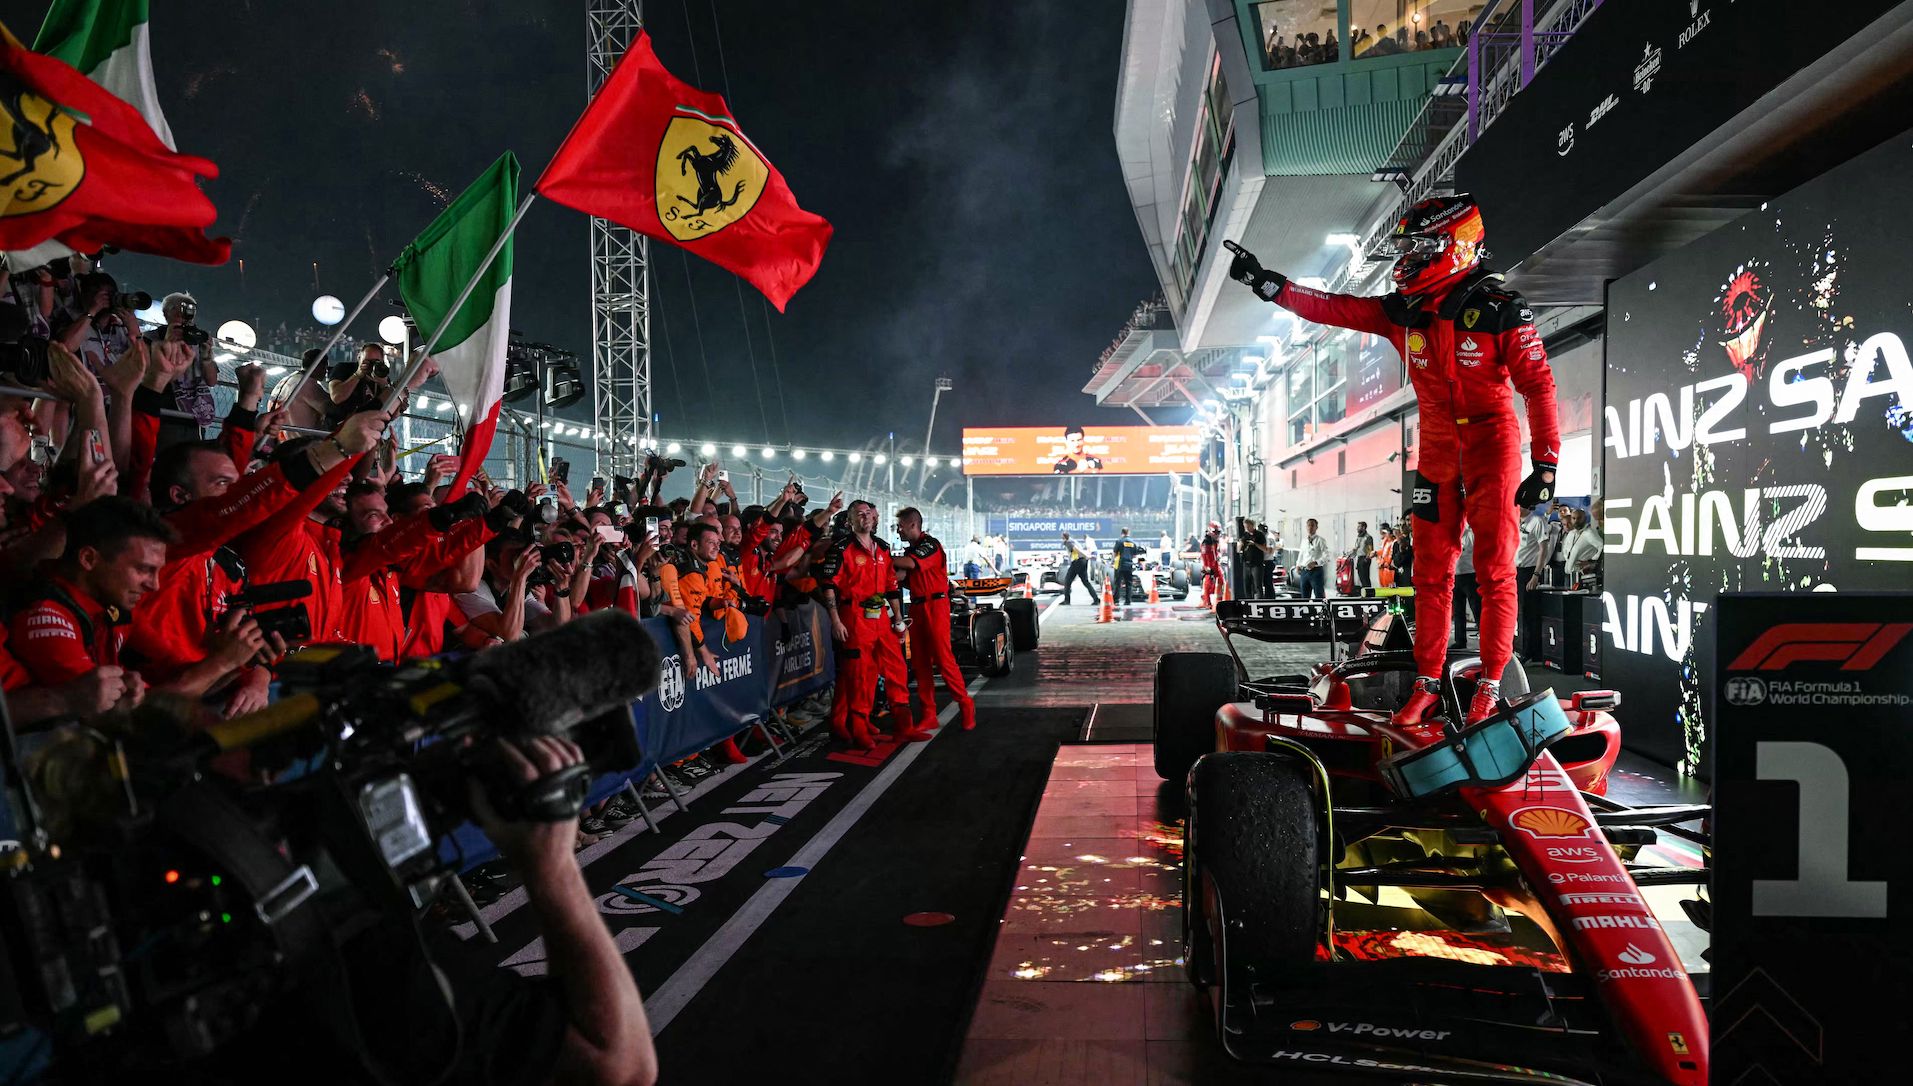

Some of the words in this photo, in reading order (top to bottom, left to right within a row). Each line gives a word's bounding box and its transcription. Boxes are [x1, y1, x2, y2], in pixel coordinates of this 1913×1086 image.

[1678, 9, 1711, 49] ROLEX
[1634, 55, 1660, 85] Heineken
[1586, 93, 1619, 130] DHL
[1558, 122, 1574, 151] aws
[1430, 201, 1464, 222] Santander
[1456, 350, 1484, 358] Santander
[1413, 488, 1431, 504] 55
[1008, 522, 1057, 532] SINGAPORE
[1058, 522, 1095, 532] AIRLINES
[1603, 483, 1827, 559] SAINZ
[1248, 601, 1388, 619] Ferar
[1548, 626, 1556, 646] 1
[1602, 591, 1708, 663] AIN
[723, 646, 752, 682] FERMÉ
[1769, 681, 1792, 692] FIA
[1795, 681, 1851, 693] Formula
[1853, 681, 1862, 692] 1
[1769, 693, 1810, 705] World
[1813, 693, 1910, 706] Championship
[1751, 741, 1888, 919] 1
[1547, 847, 1598, 860] aws
[1327, 1022, 1452, 1041] V-Power
